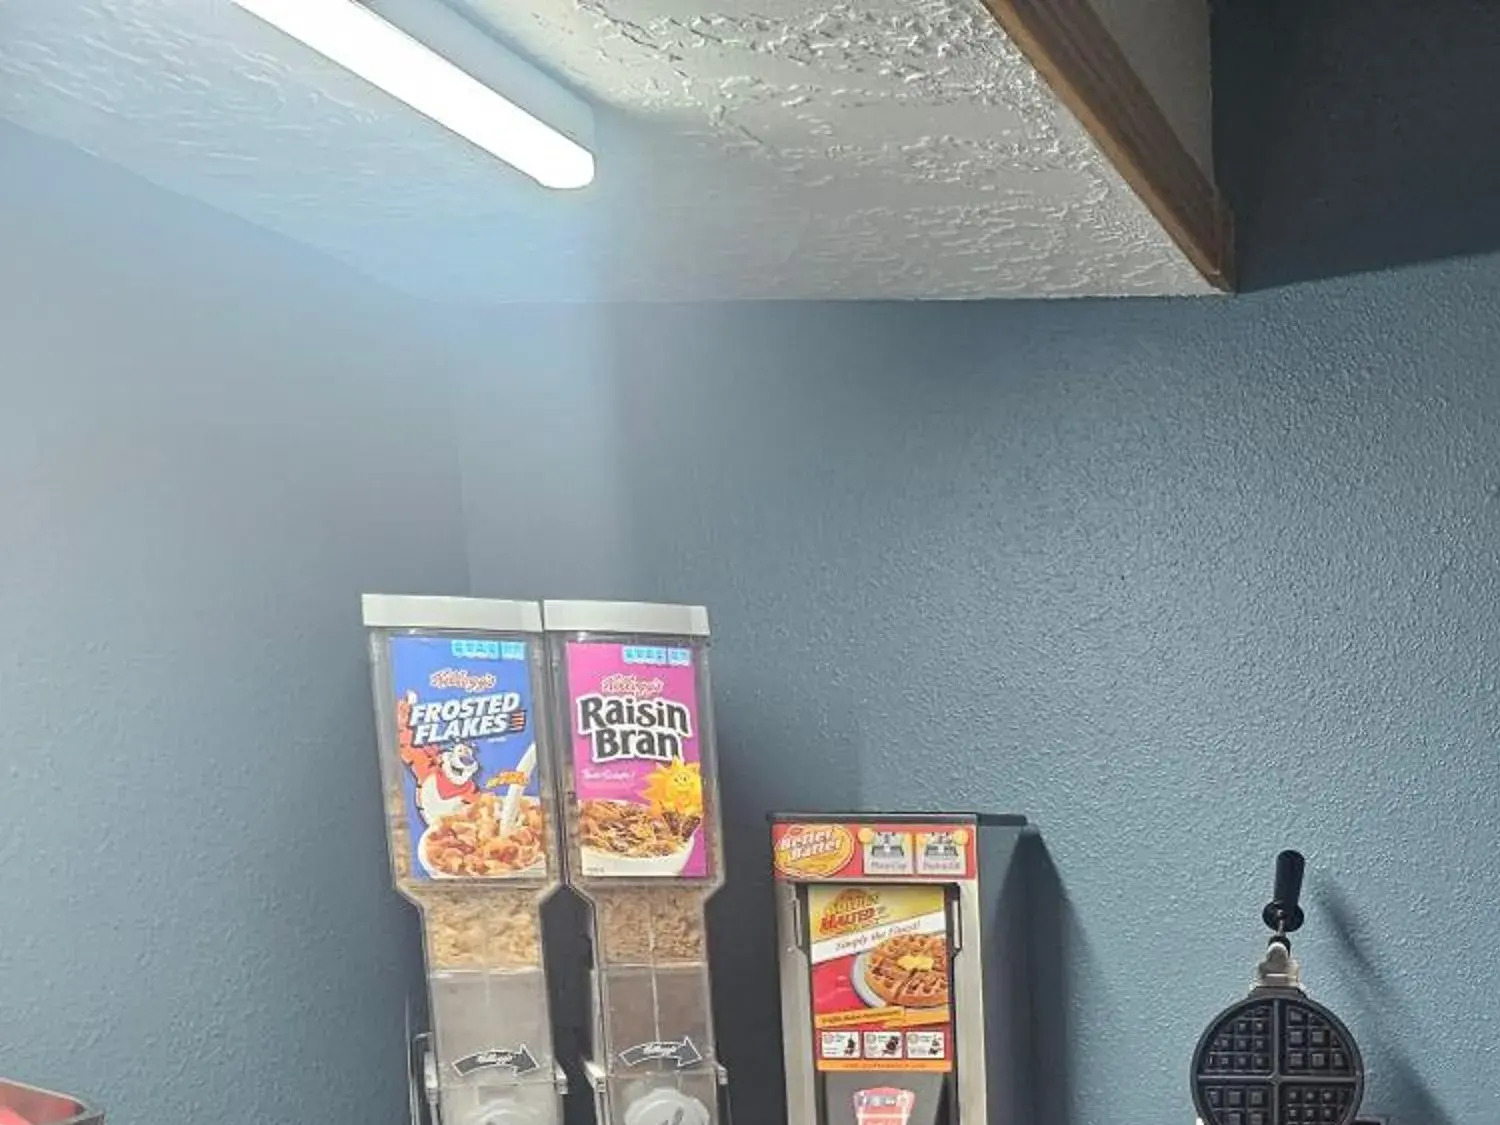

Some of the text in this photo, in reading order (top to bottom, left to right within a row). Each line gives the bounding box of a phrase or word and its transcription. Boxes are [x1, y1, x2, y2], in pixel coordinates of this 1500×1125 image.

[409, 692, 520, 726] FROSTED
[578, 695, 691, 735] Raisin
[413, 712, 509, 746] FLAKES
[594, 727, 681, 760] Bran
